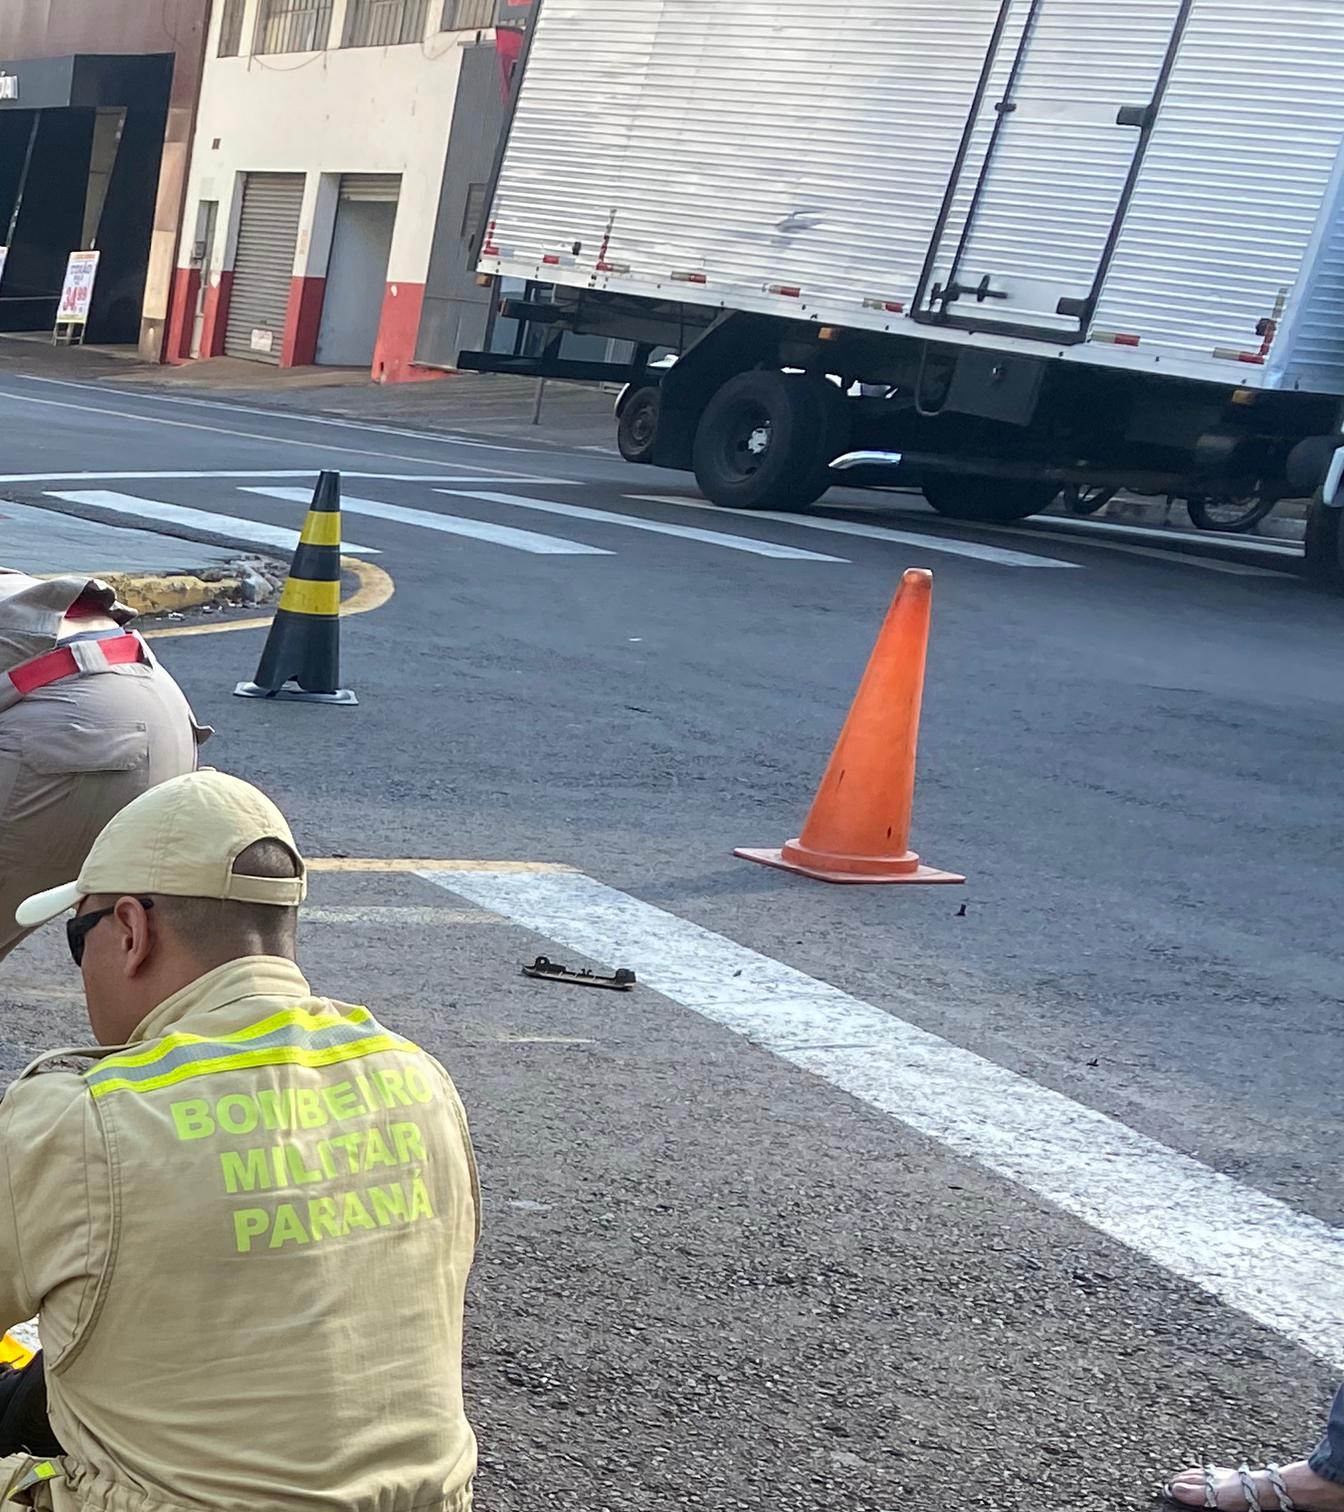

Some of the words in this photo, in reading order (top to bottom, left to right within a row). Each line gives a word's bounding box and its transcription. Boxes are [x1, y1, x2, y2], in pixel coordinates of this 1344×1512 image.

[170, 1065, 434, 1141] BOMBEIRO
[220, 1122, 428, 1194] MILITAR
[233, 1166, 436, 1253] PARANÁ
